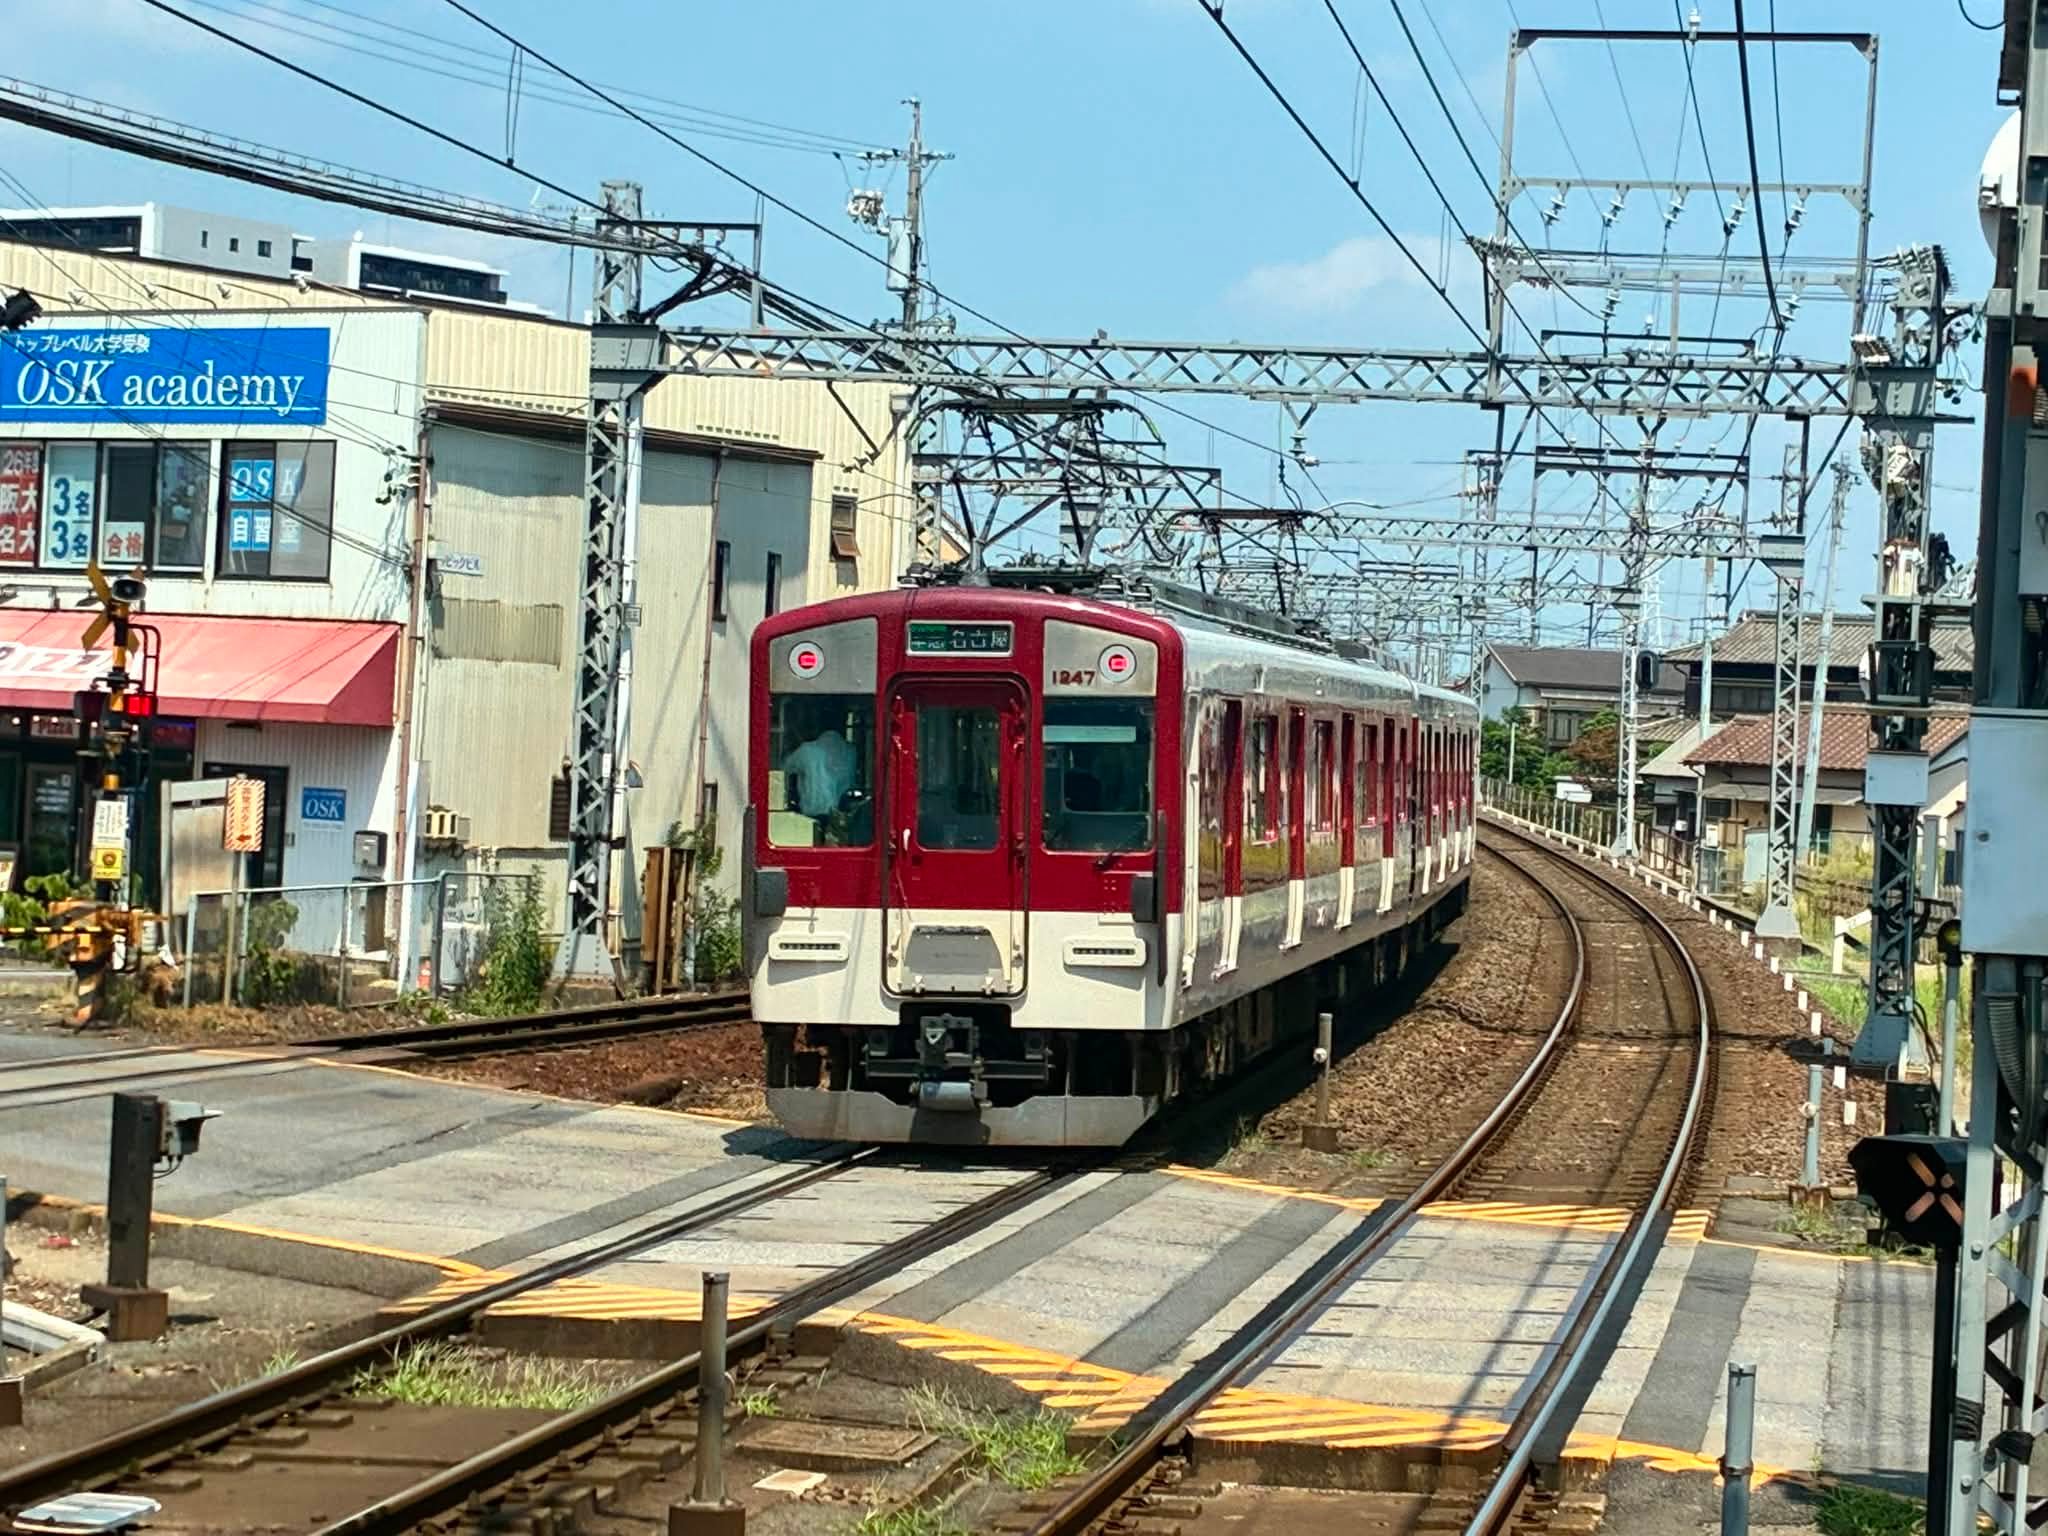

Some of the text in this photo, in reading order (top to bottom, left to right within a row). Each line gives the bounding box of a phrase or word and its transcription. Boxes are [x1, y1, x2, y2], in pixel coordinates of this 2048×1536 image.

[17, 359, 304, 417] OSK academy
[53, 478, 90, 517] 3名
[231, 466, 302, 497] OSK
[51, 520, 88, 559] 3名
[305, 798, 344, 818] OSK
